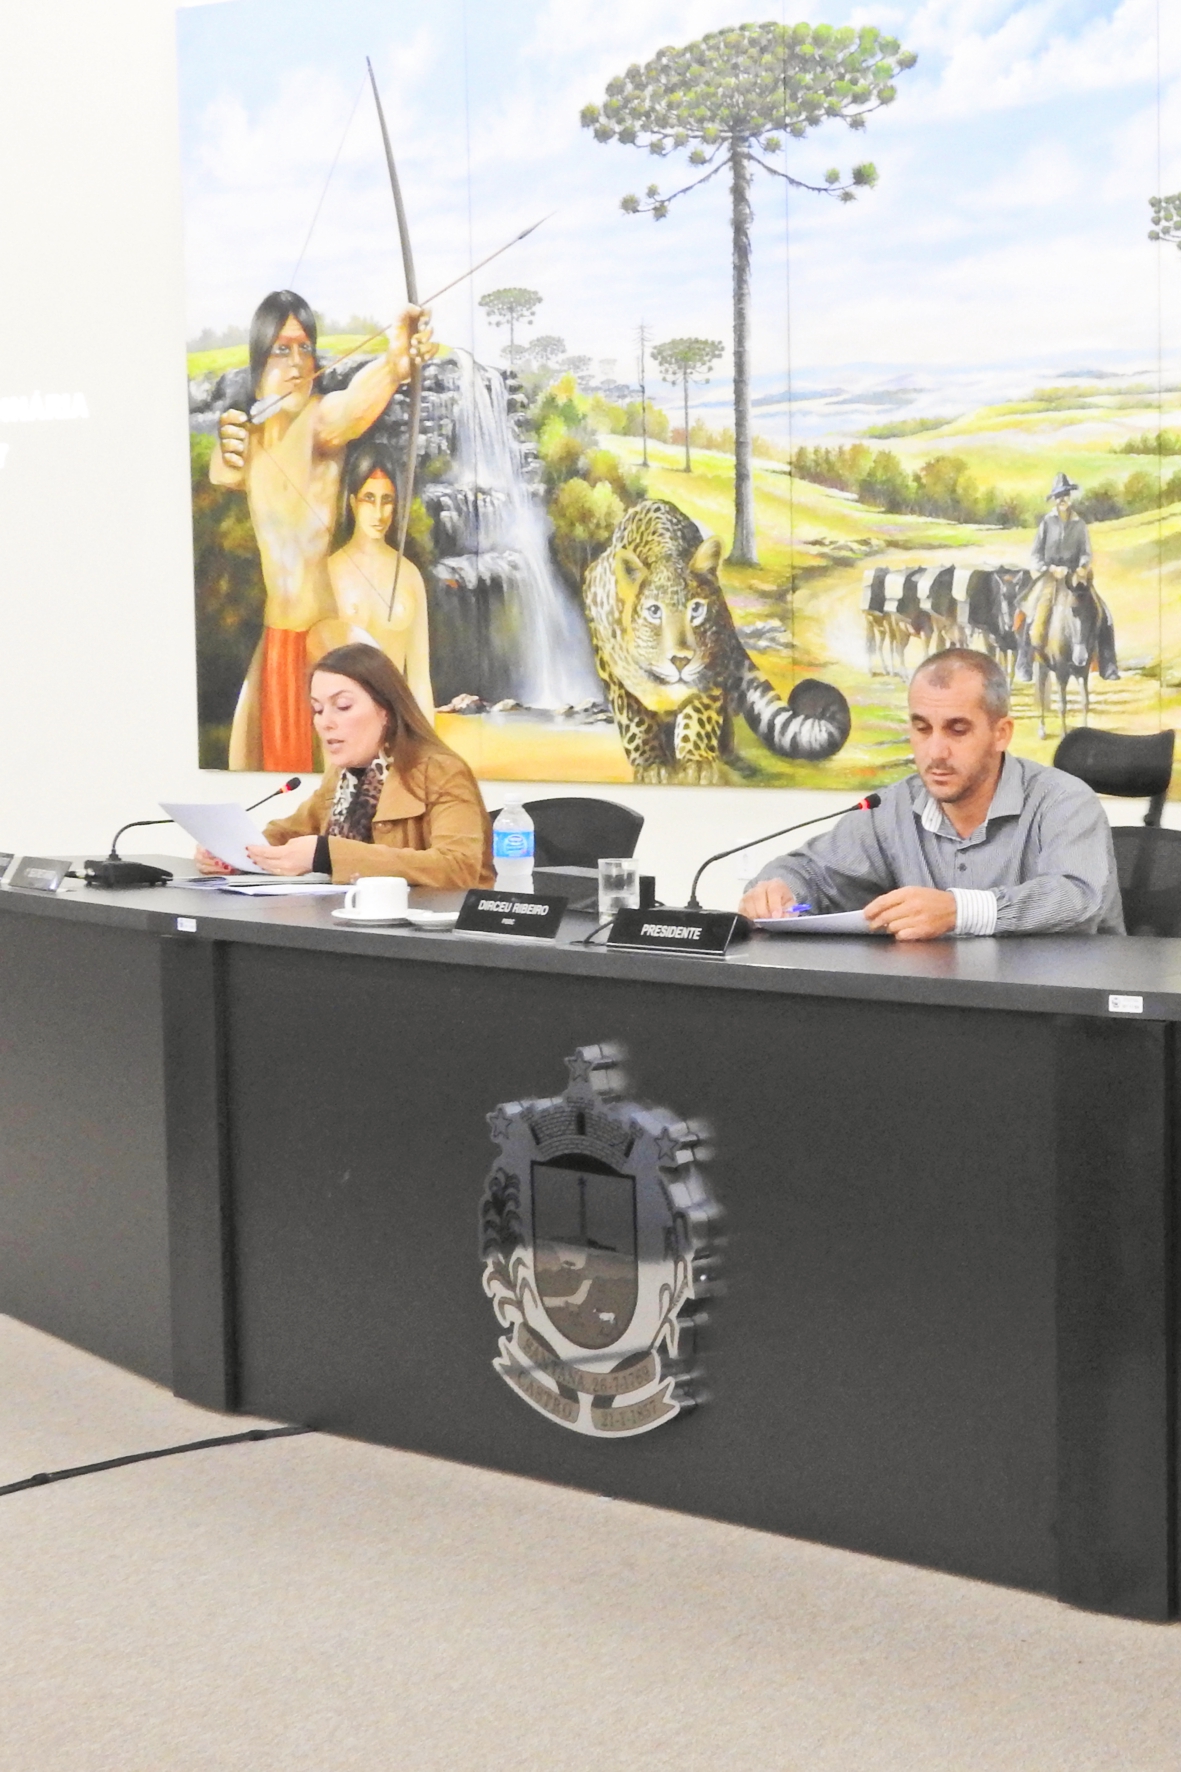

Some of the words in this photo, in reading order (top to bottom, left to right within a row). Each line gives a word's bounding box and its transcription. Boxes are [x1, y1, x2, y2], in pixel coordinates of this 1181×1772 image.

[477, 899, 513, 914] DIRCEU
[512, 902, 550, 916] RIBEIRO
[640, 923, 703, 940] PRESIDENTE
[517, 1369, 573, 1419] CASTRO
